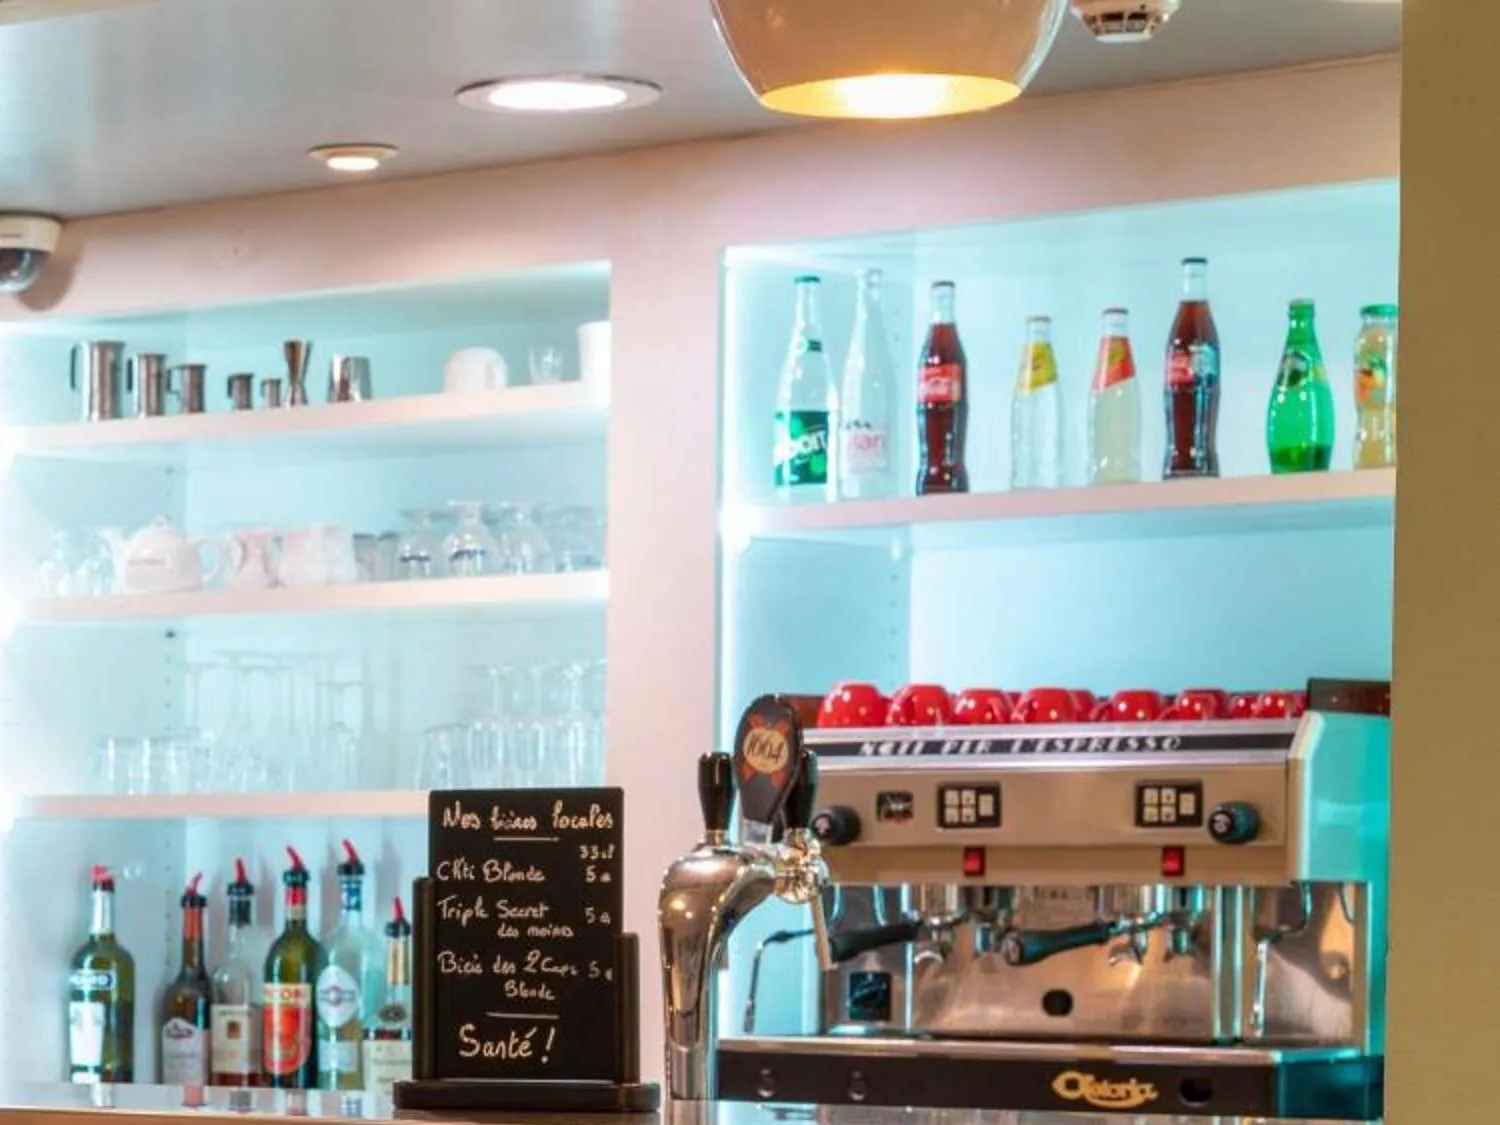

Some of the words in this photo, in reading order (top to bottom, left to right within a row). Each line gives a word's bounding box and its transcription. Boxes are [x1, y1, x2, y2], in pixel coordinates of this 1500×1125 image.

[443, 800, 481, 830] Nos
[552, 800, 614, 830] locales
[482, 858, 546, 883] Blonde
[496, 899, 549, 919] Secret
[527, 922, 575, 938] moines
[492, 954, 517, 975] des
[504, 979, 557, 1000] Blonde
[458, 1022, 539, 1061] Santé
